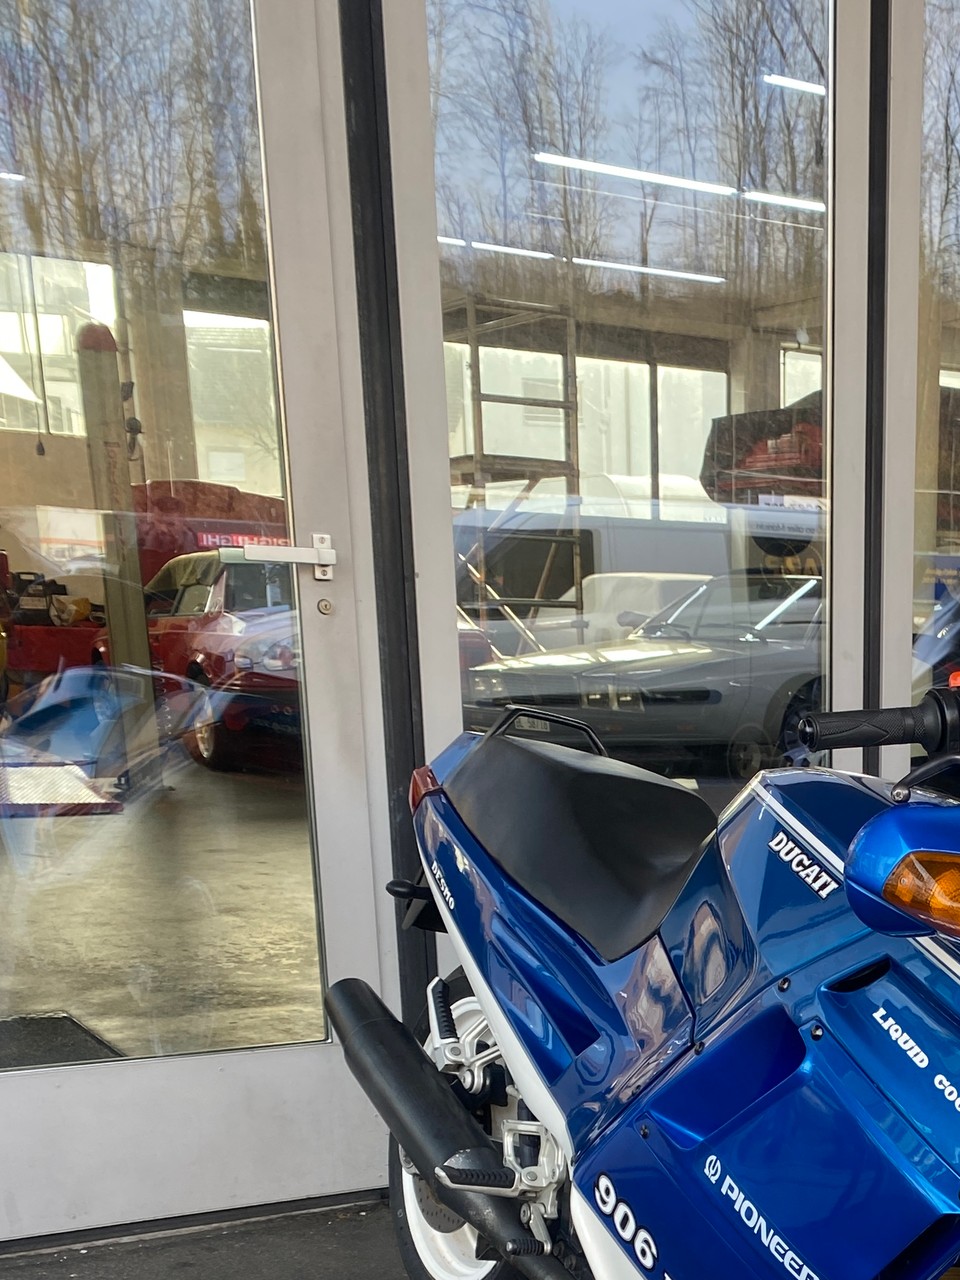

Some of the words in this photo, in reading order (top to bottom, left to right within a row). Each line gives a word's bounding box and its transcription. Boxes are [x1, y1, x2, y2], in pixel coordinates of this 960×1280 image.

[431, 860, 455, 910] DESMO
[767, 830, 840, 900] DUCATI
[872, 1007, 929, 1069] LIQUID
[594, 1173, 658, 1270] 906
